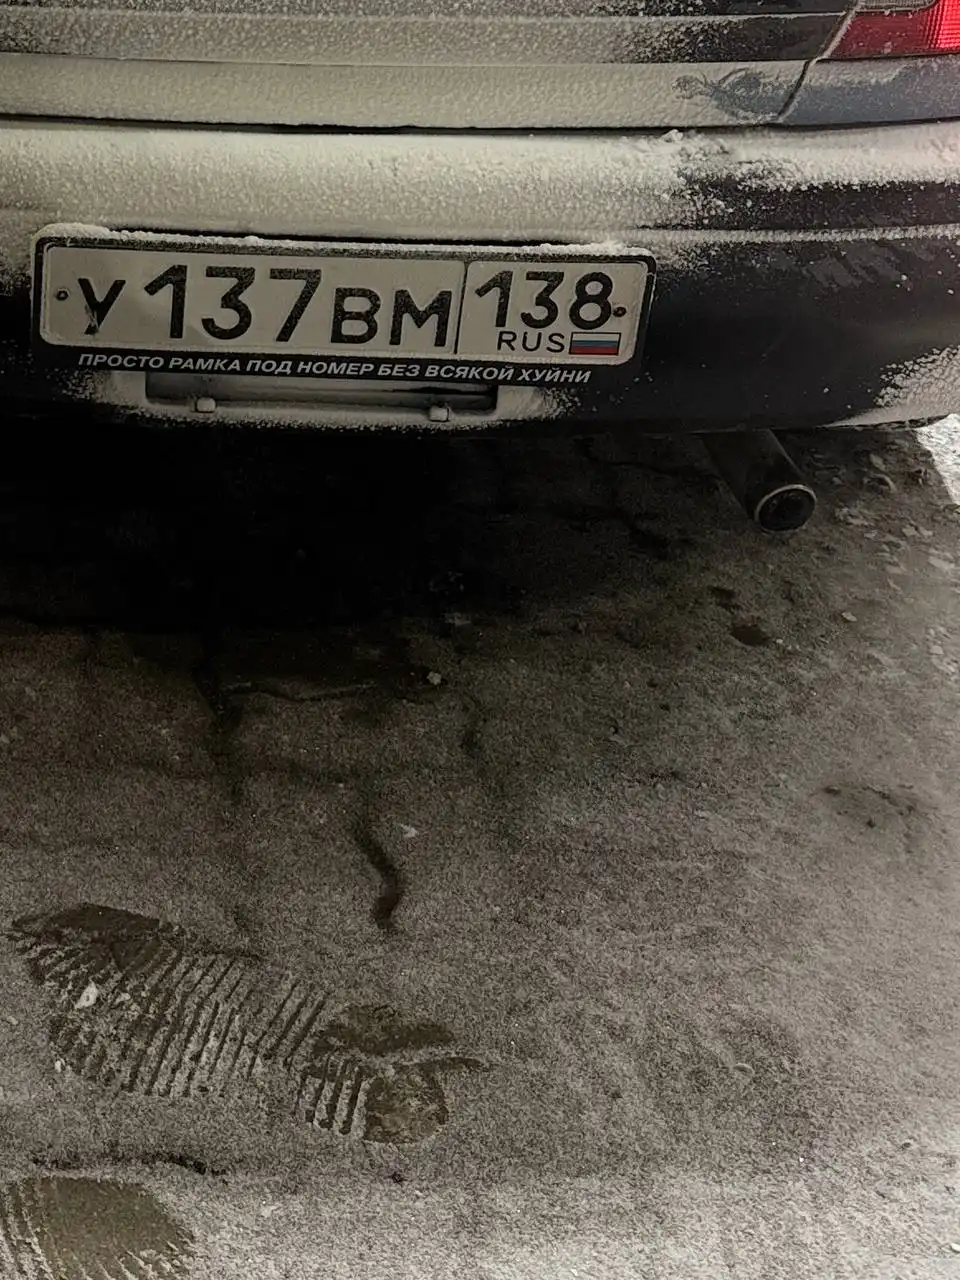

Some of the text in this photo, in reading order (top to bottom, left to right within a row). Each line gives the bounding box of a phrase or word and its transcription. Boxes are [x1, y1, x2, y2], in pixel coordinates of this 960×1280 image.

[475, 270, 613, 330] 138
[497, 330, 565, 354] RUS
[78, 353, 591, 384] ПРОСТО РАМКА ПОД НОМЕР БЕЗ ВСЯКОЙ ХУЙНИ
